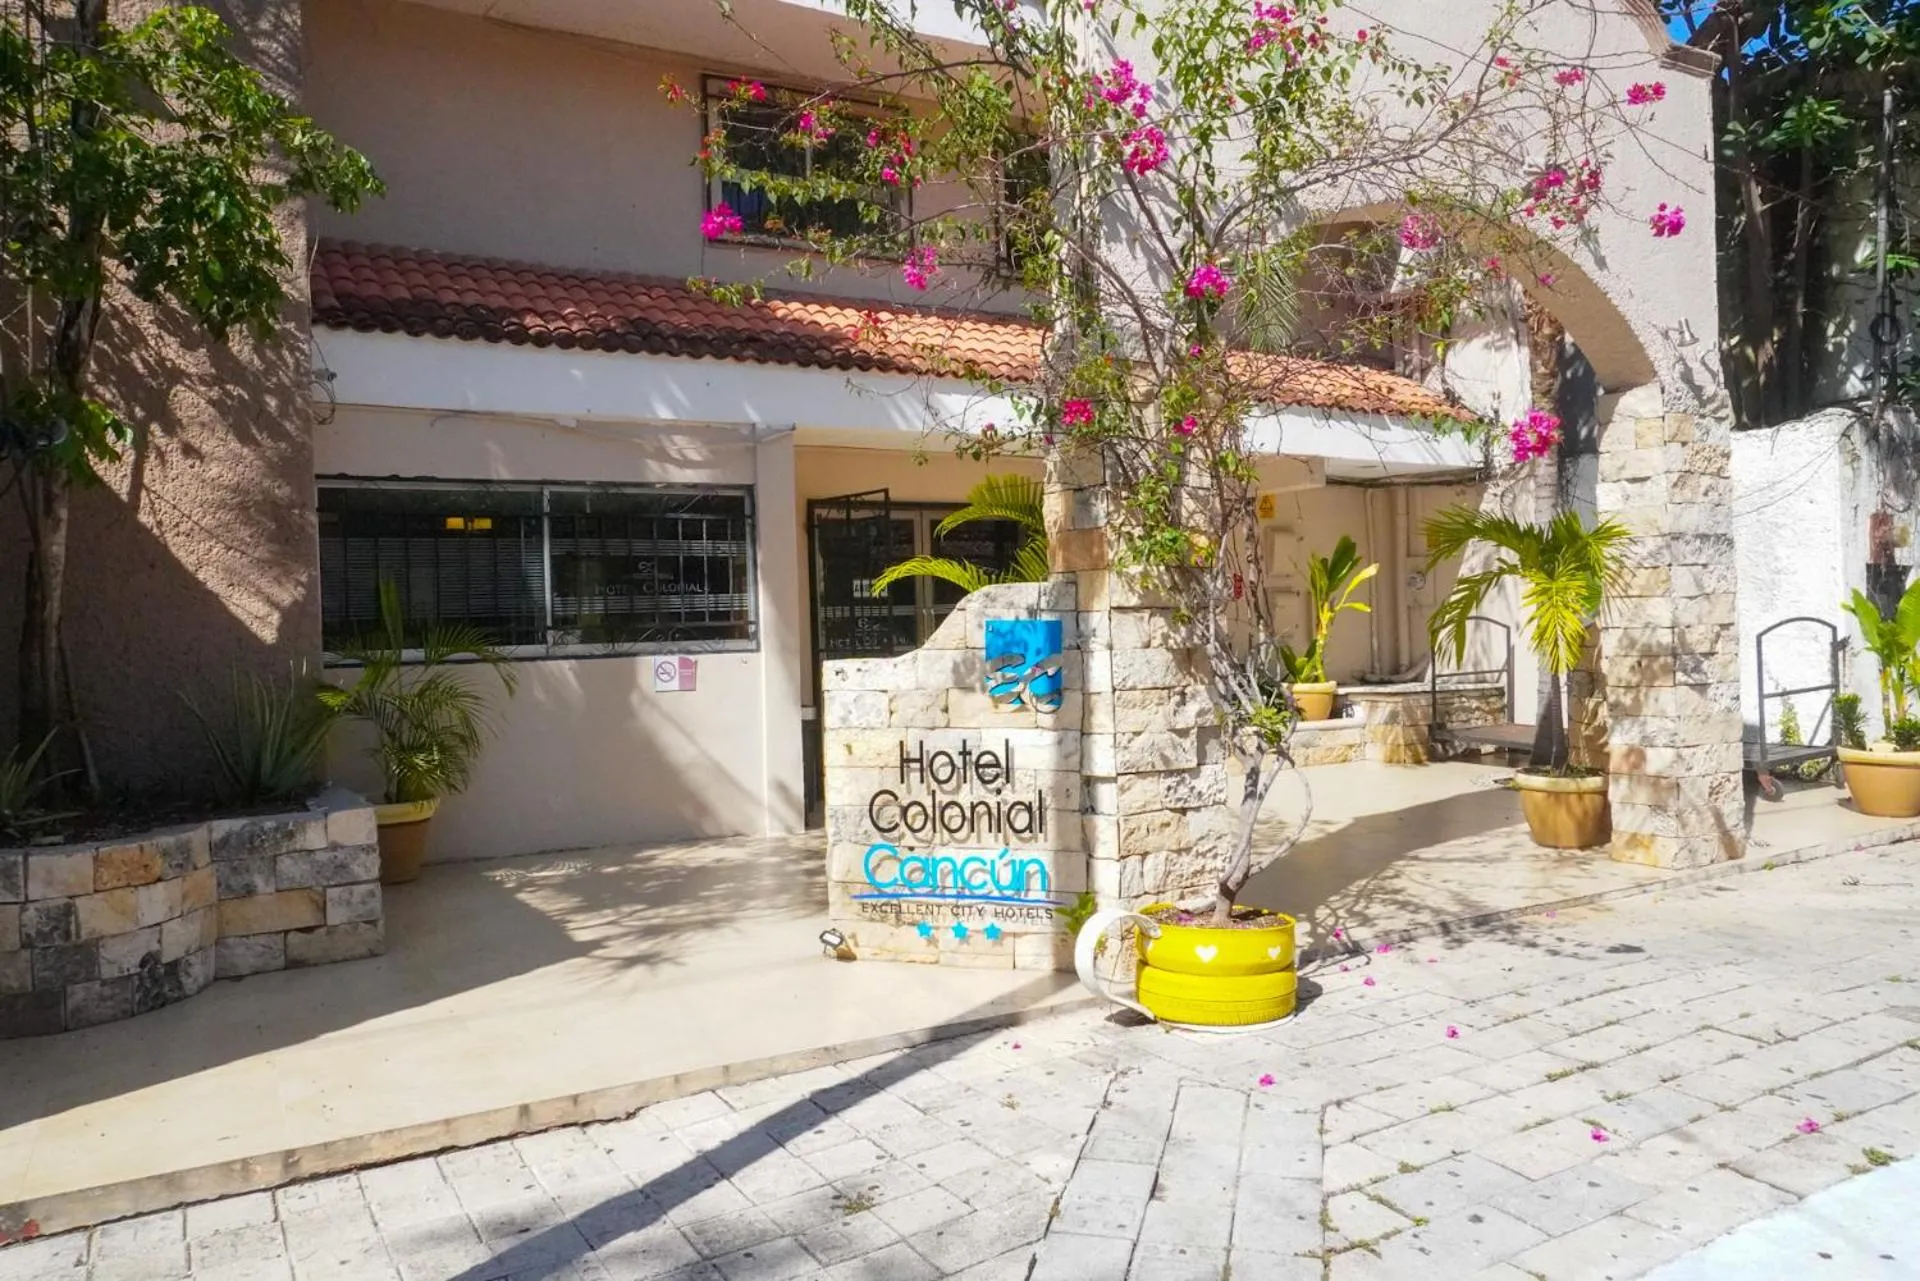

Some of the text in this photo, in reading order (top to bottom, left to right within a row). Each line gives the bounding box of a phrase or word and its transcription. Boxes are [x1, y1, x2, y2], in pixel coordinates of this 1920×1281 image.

[595, 582, 703, 595] OTE CLOIAL
[899, 738, 1010, 785] Hotel
[869, 789, 1043, 834] Colonial
[863, 842, 1049, 892] Cancún
[861, 902, 1054, 920] EXCELLENT CITY HOTELS
